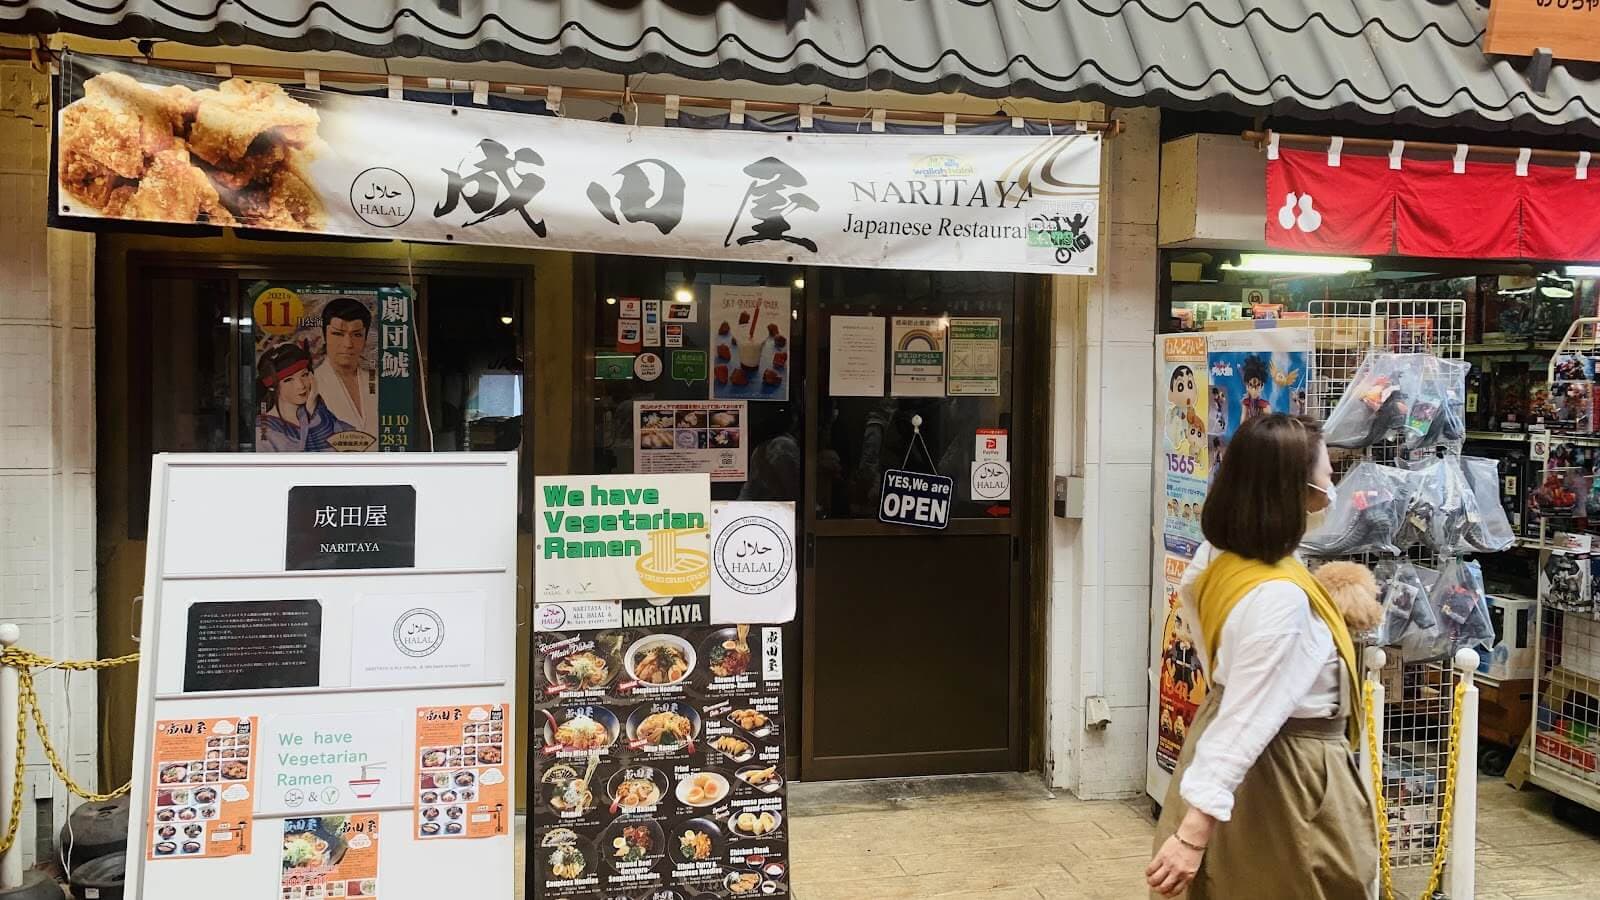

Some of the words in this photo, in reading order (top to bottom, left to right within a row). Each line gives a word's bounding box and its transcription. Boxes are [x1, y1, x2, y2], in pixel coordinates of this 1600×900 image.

[364, 182, 402, 201] حلال
[434, 138, 820, 251] 成田屋
[848, 179, 1033, 209] NARITAYA
[360, 202, 405, 217] HALAL
[843, 212, 932, 239] Japanese
[938, 217, 1030, 240] Restaura
[263, 301, 293, 327] 11
[980, 467, 1004, 479] حلال
[1166, 453, 1194, 474] 1565
[543, 485, 585, 507] We
[591, 485, 659, 506] have
[931, 484, 950, 494] are
[313, 504, 388, 528] 成田屋
[883, 494, 948, 524] OPEN
[543, 509, 705, 533] Vegetarian
[320, 543, 380, 553] NARITAYA
[544, 537, 642, 559] Ramen
[737, 540, 772, 557] حلال
[732, 562, 776, 573] HALAL
[623, 604, 702, 627] NARITAYA
[408, 623, 433, 635] حلال
[404, 636, 433, 645] HALAL
[278, 731, 304, 745] We
[314, 730, 352, 744] have
[278, 750, 368, 767] Vegetarian
[277, 772, 332, 786] Ramen
